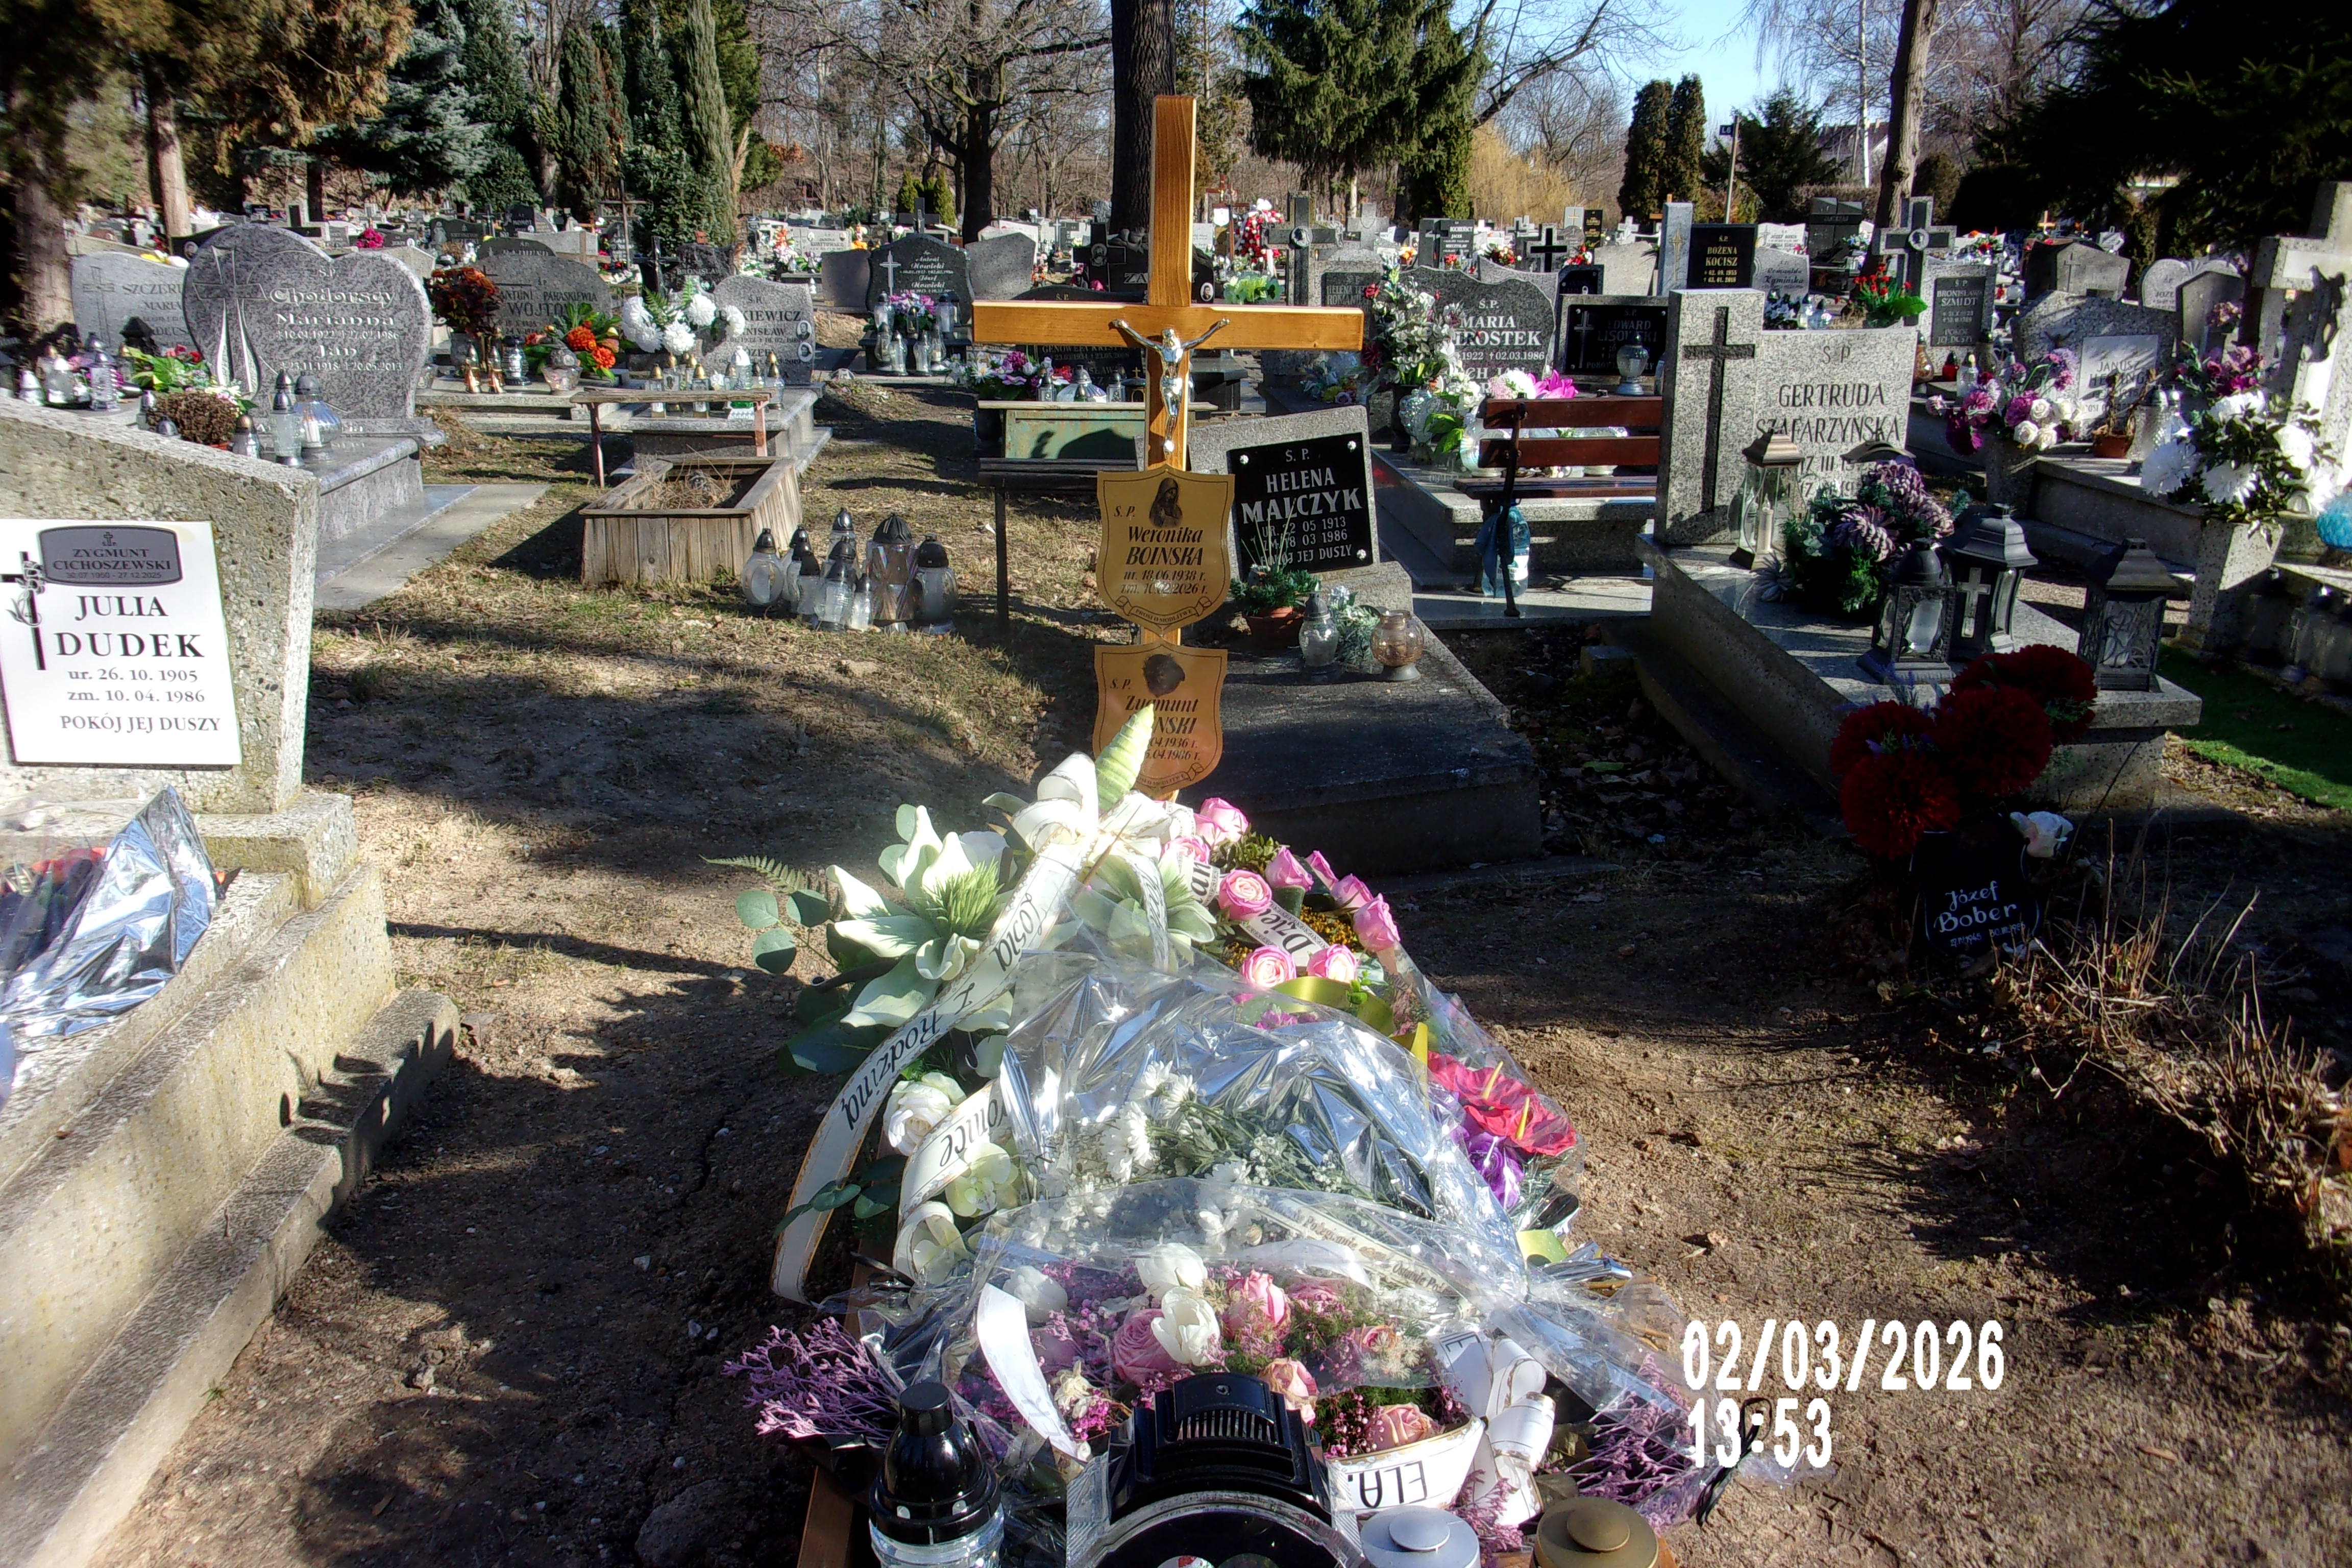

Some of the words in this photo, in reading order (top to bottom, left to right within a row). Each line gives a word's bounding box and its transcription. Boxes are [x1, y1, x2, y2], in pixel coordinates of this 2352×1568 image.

[1707, 245, 1738, 255] BOŻENA
[1705, 257, 1738, 266] KOCISZ
[276, 312, 395, 326] Marianna
[1459, 315, 1516, 328] MARIA
[1608, 320, 1652, 330] EDWARD
[316, 345, 357, 359] Jan
[1778, 383, 1885, 408] GERTRUDA
[1265, 467, 1336, 494] HELENA
[1321, 516, 1346, 530] 1913
[1128, 526, 1204, 544] Weronika
[1321, 528, 1348, 544] 1986
[72, 548, 150, 558] ZYGMUNT
[1296, 549, 1314, 563] JEJ
[1319, 544, 1353, 560] DUSZY
[53, 560, 172, 571] CICHOSZEWSKI
[1123, 571, 1138, 581] ur.
[1141, 569, 1197, 581] 18.06.1938
[75, 595, 169, 621] JULIA
[53, 632, 206, 658] DUDEK
[67, 669, 93, 680] ur.
[67, 691, 100, 701] zm.
[59, 712, 122, 734] POKÓJ
[127, 716, 154, 734] JEJ
[159, 717, 221, 732] DUSZY
[1944, 880, 1998, 912] Józef
[1933, 903, 2017, 933] Bober
[841, 1010, 943, 1131] Rodziną
